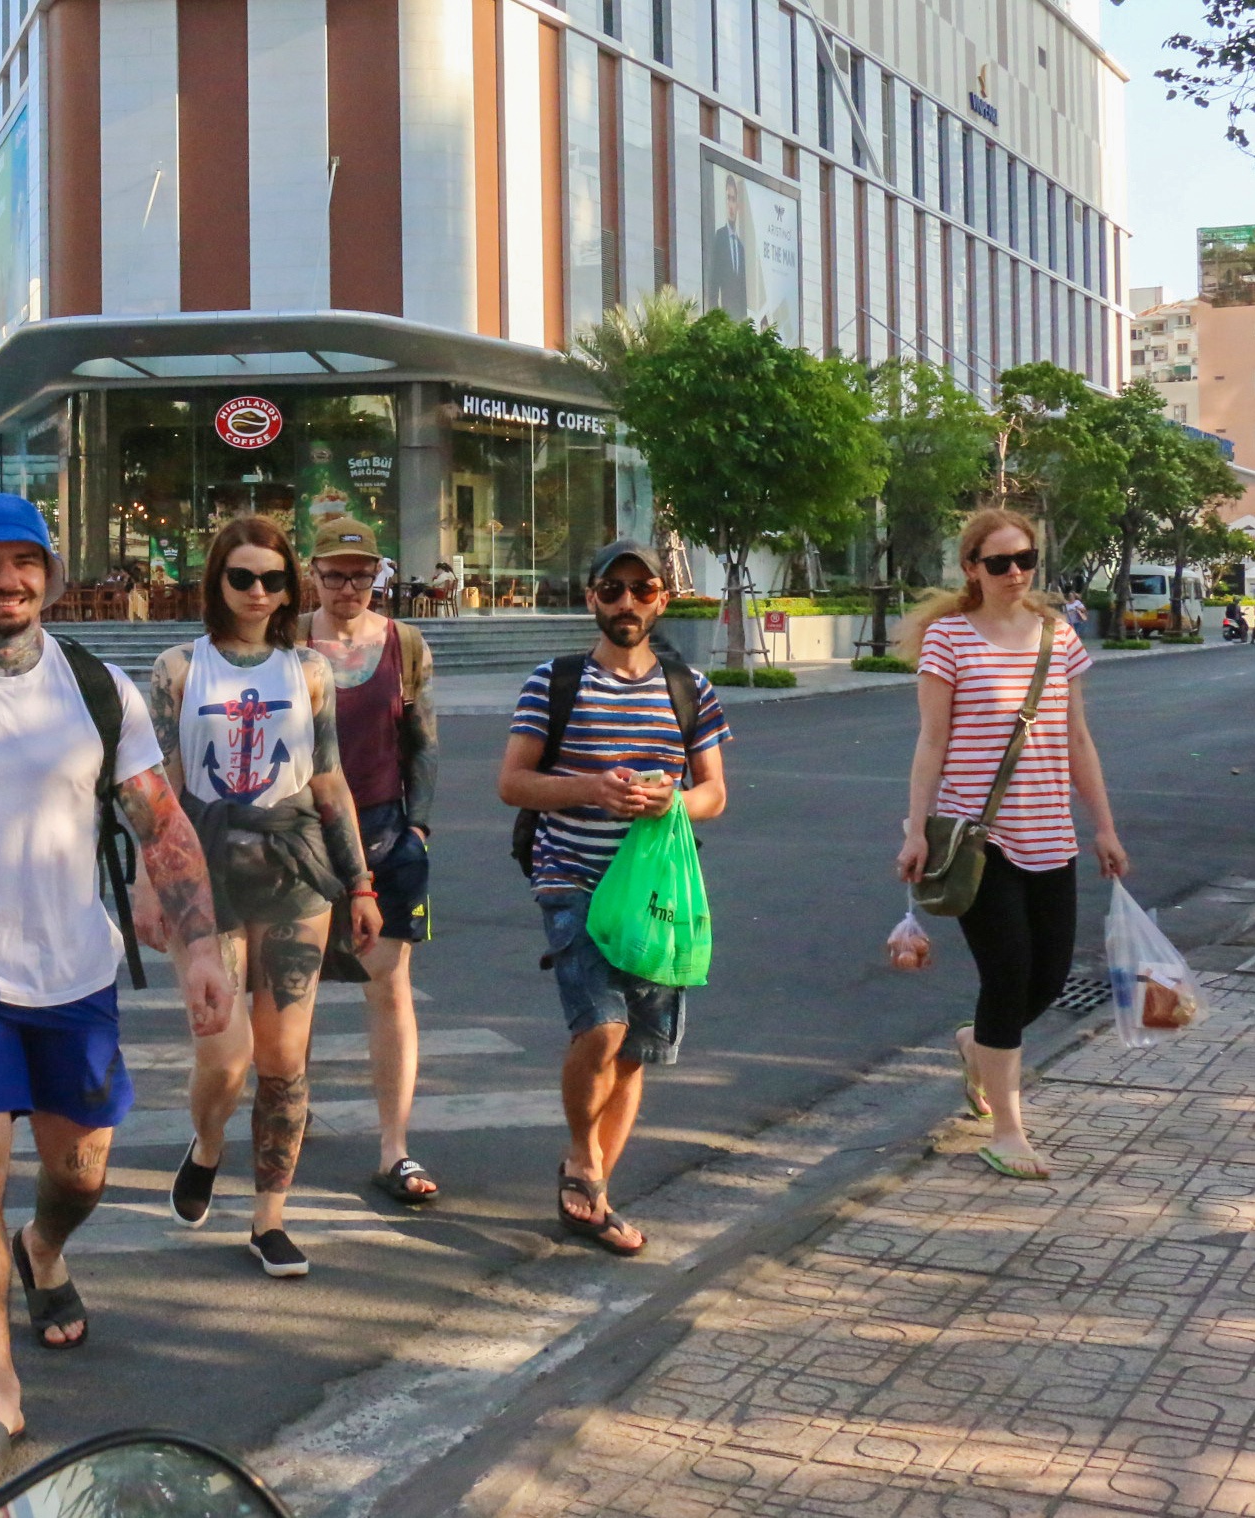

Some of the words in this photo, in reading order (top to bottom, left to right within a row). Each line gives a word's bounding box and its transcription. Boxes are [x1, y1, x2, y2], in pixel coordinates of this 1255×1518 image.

[219, 399, 279, 421] HIGHLANDS
[463, 394, 549, 425] HIGHLANDS
[225, 432, 271, 446] COFFEE
[348, 457, 370, 469] Sen
[402, 1160, 421, 1169] NIKE
